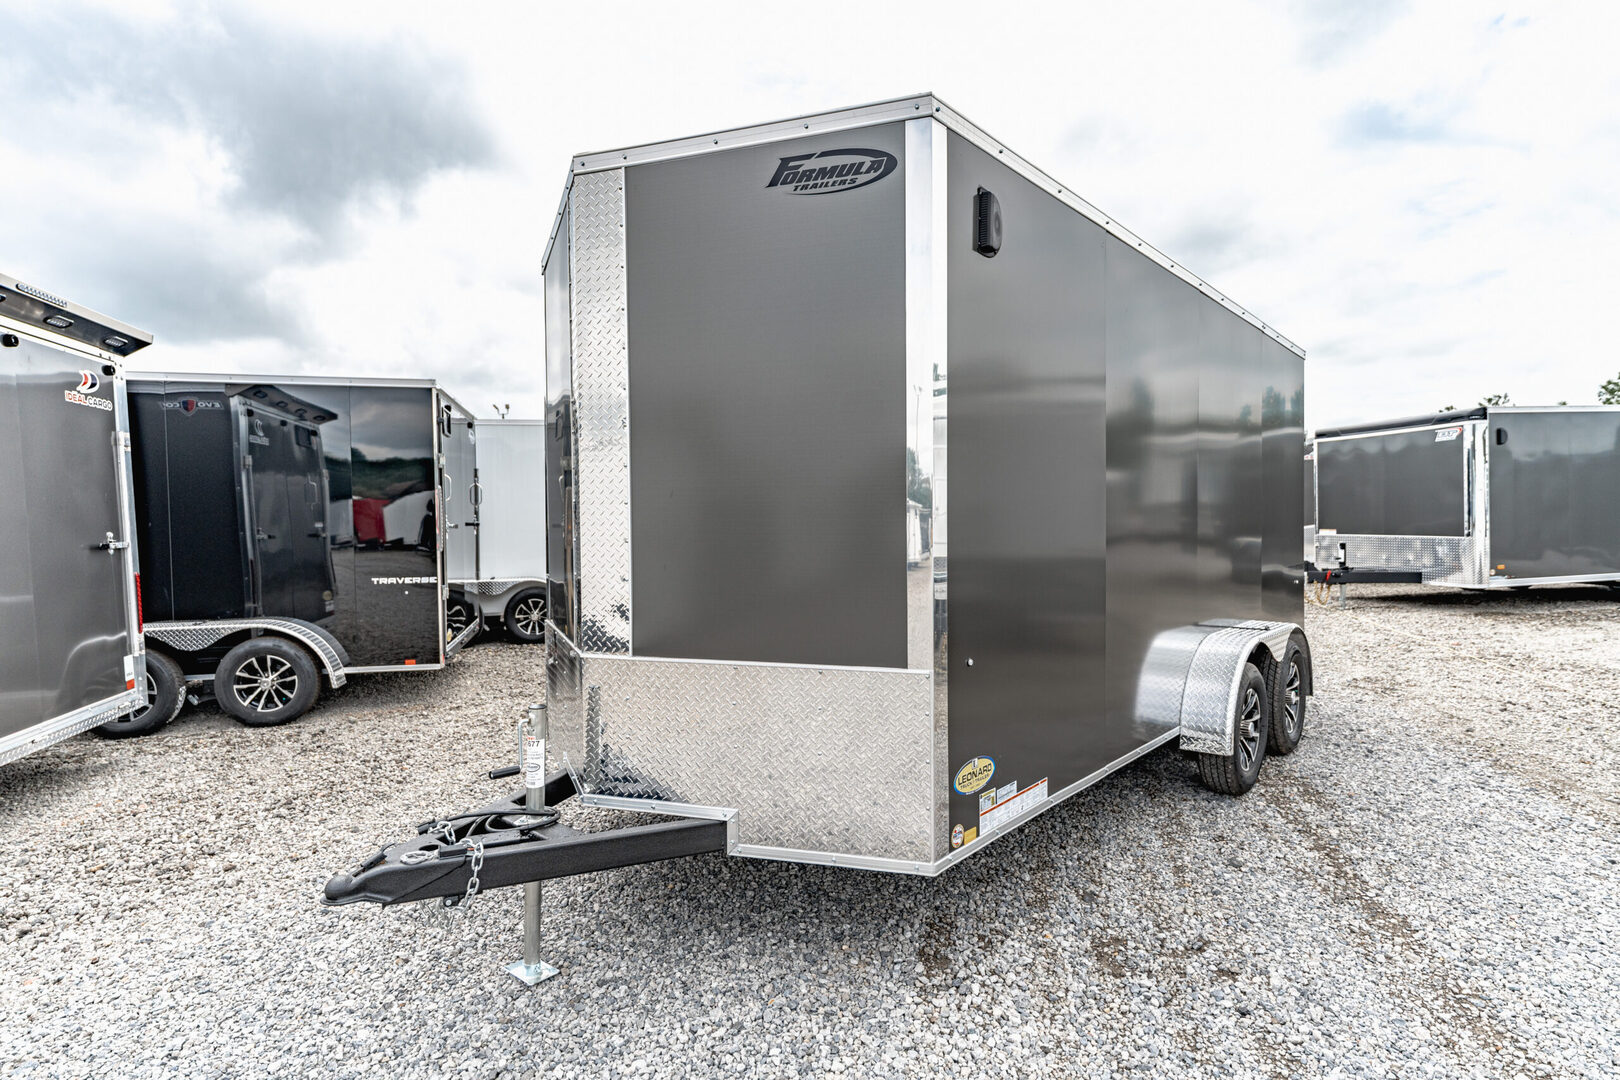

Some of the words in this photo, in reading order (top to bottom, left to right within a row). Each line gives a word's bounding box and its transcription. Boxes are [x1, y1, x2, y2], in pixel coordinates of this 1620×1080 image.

[765, 152, 886, 188] FORMULA
[793, 177, 858, 192] TRAILERS
[65, 391, 88, 404] IDEAL
[87, 397, 112, 410] CARGO
[371, 576, 437, 585] TRAVERSE
[957, 762, 992, 786] LEONARD
